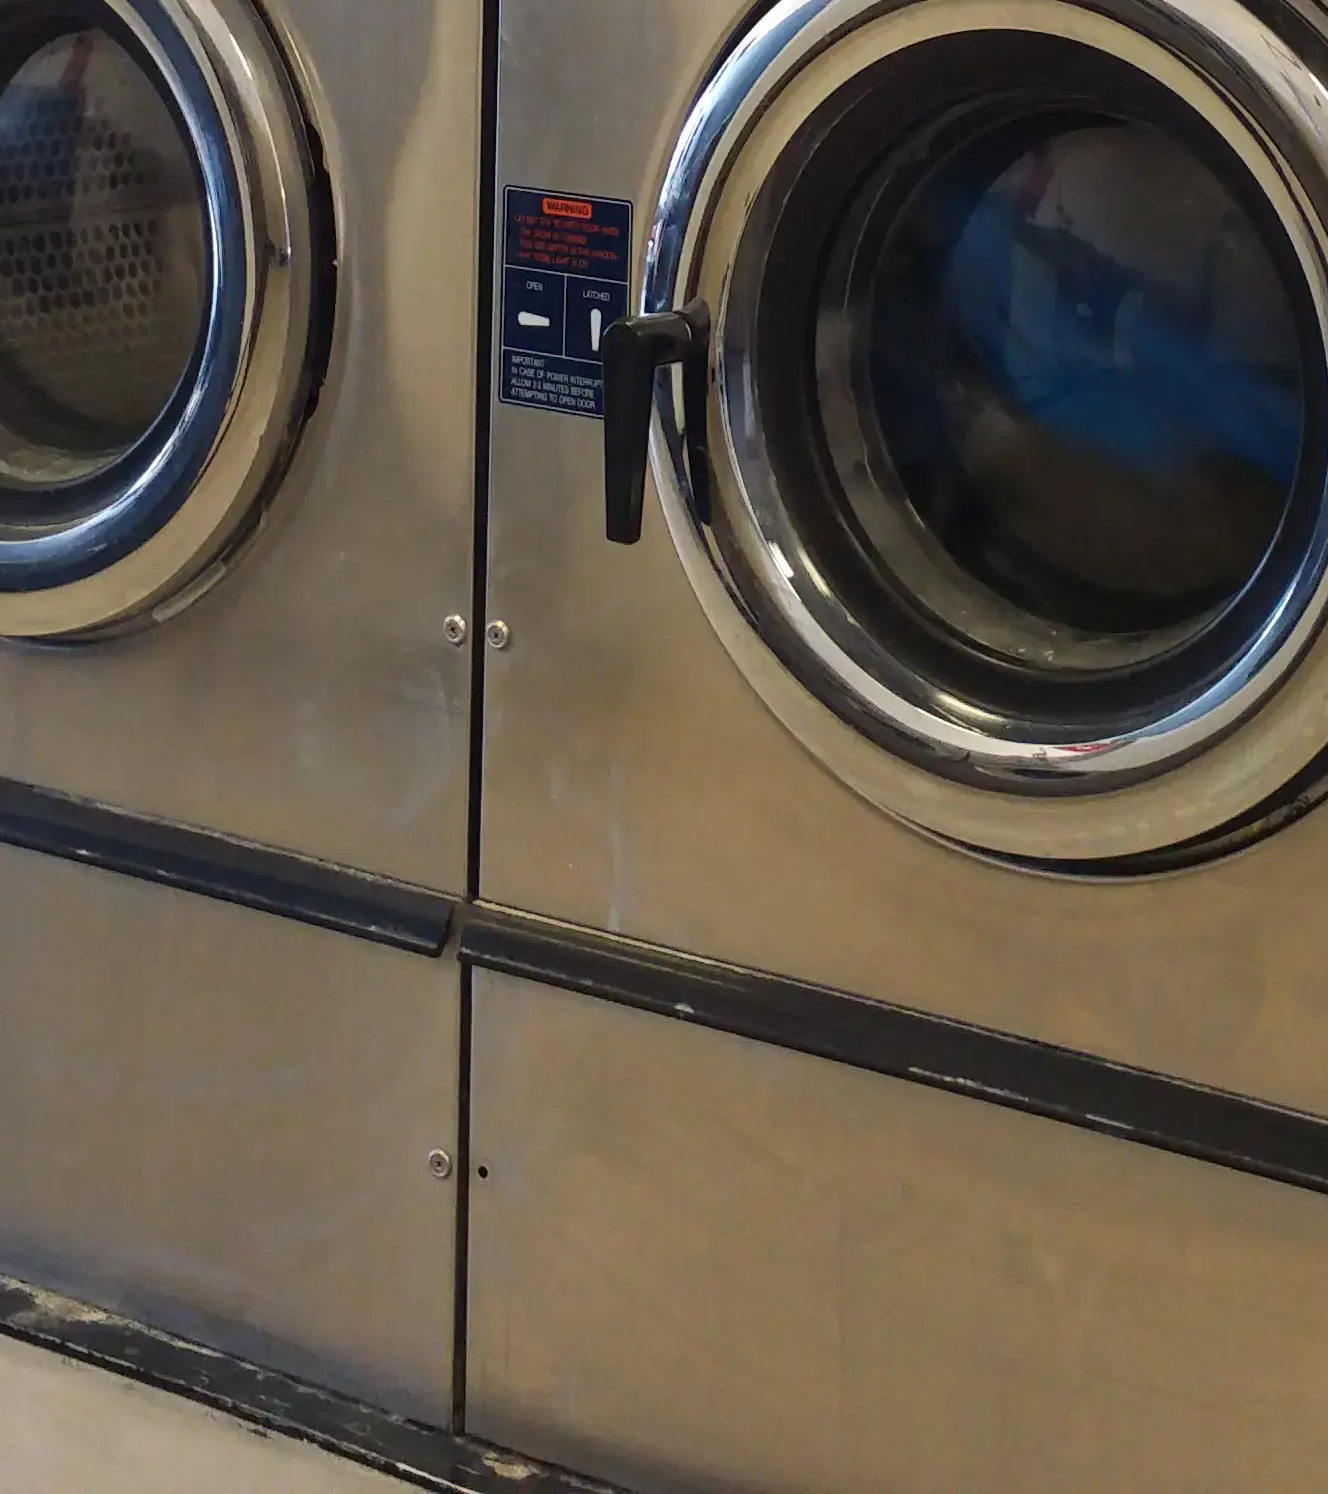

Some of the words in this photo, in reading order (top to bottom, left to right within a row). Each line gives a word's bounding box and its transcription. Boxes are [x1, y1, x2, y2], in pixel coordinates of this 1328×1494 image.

[546, 201, 589, 216] WARNING
[526, 280, 543, 291] OPEN
[583, 290, 611, 302] LATCHED
[519, 367, 535, 377] CASE
[536, 369, 545, 379] OF
[547, 371, 569, 383] POWER
[511, 378, 532, 388] ALLOW
[543, 382, 570, 395] MINUTES
[570, 386, 595, 399] BEFORE
[511, 387, 548, 402] ATTEMPTING
[549, 394, 558, 403] TO
[559, 395, 576, 406] OPEN
[577, 399, 596, 409] DOOR
